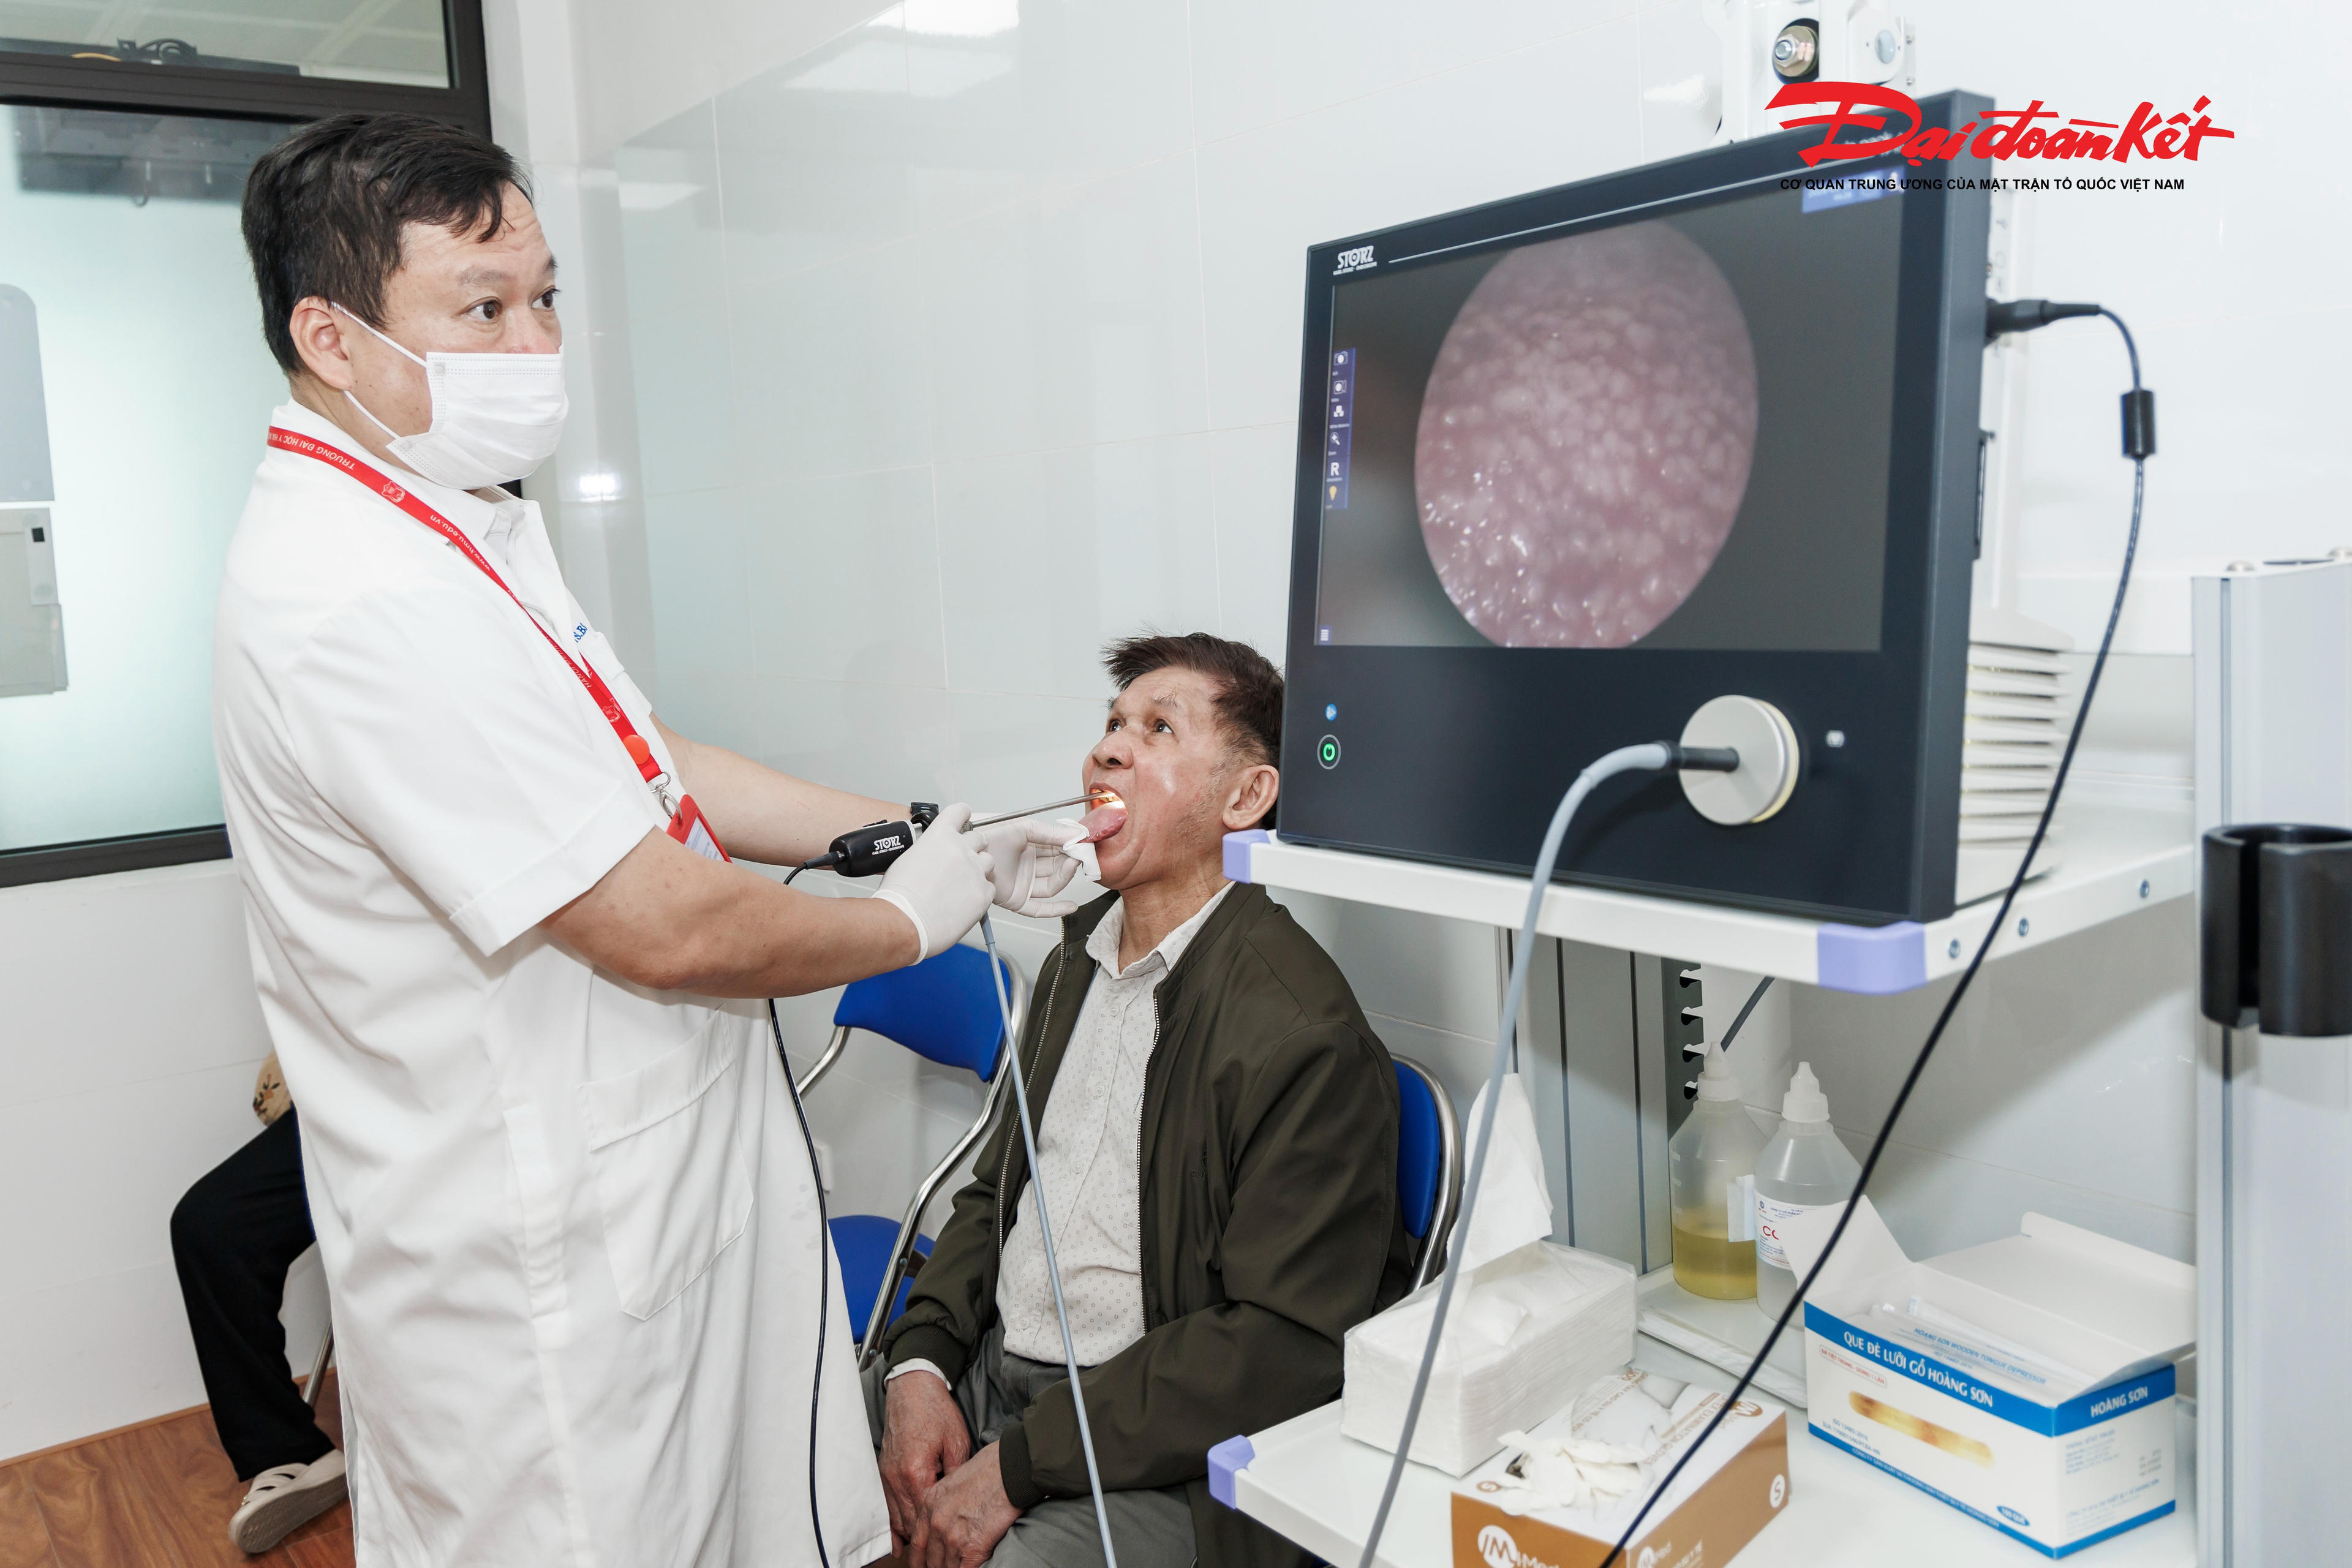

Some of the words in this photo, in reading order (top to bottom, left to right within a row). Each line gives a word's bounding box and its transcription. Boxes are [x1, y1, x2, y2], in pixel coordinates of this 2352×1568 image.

[1337, 245, 1374, 269] STORZ
[430, 514, 491, 571] www.hmu.edu.vn
[874, 835, 901, 851] STORZ
[1844, 1331, 1864, 1351] QUE
[1928, 1368, 1968, 1397] HOÀNG
[1970, 1385, 1993, 1408] SƠN
[2090, 1393, 2127, 1418] HOÀNG
[2128, 1385, 2148, 1404] SƠN
